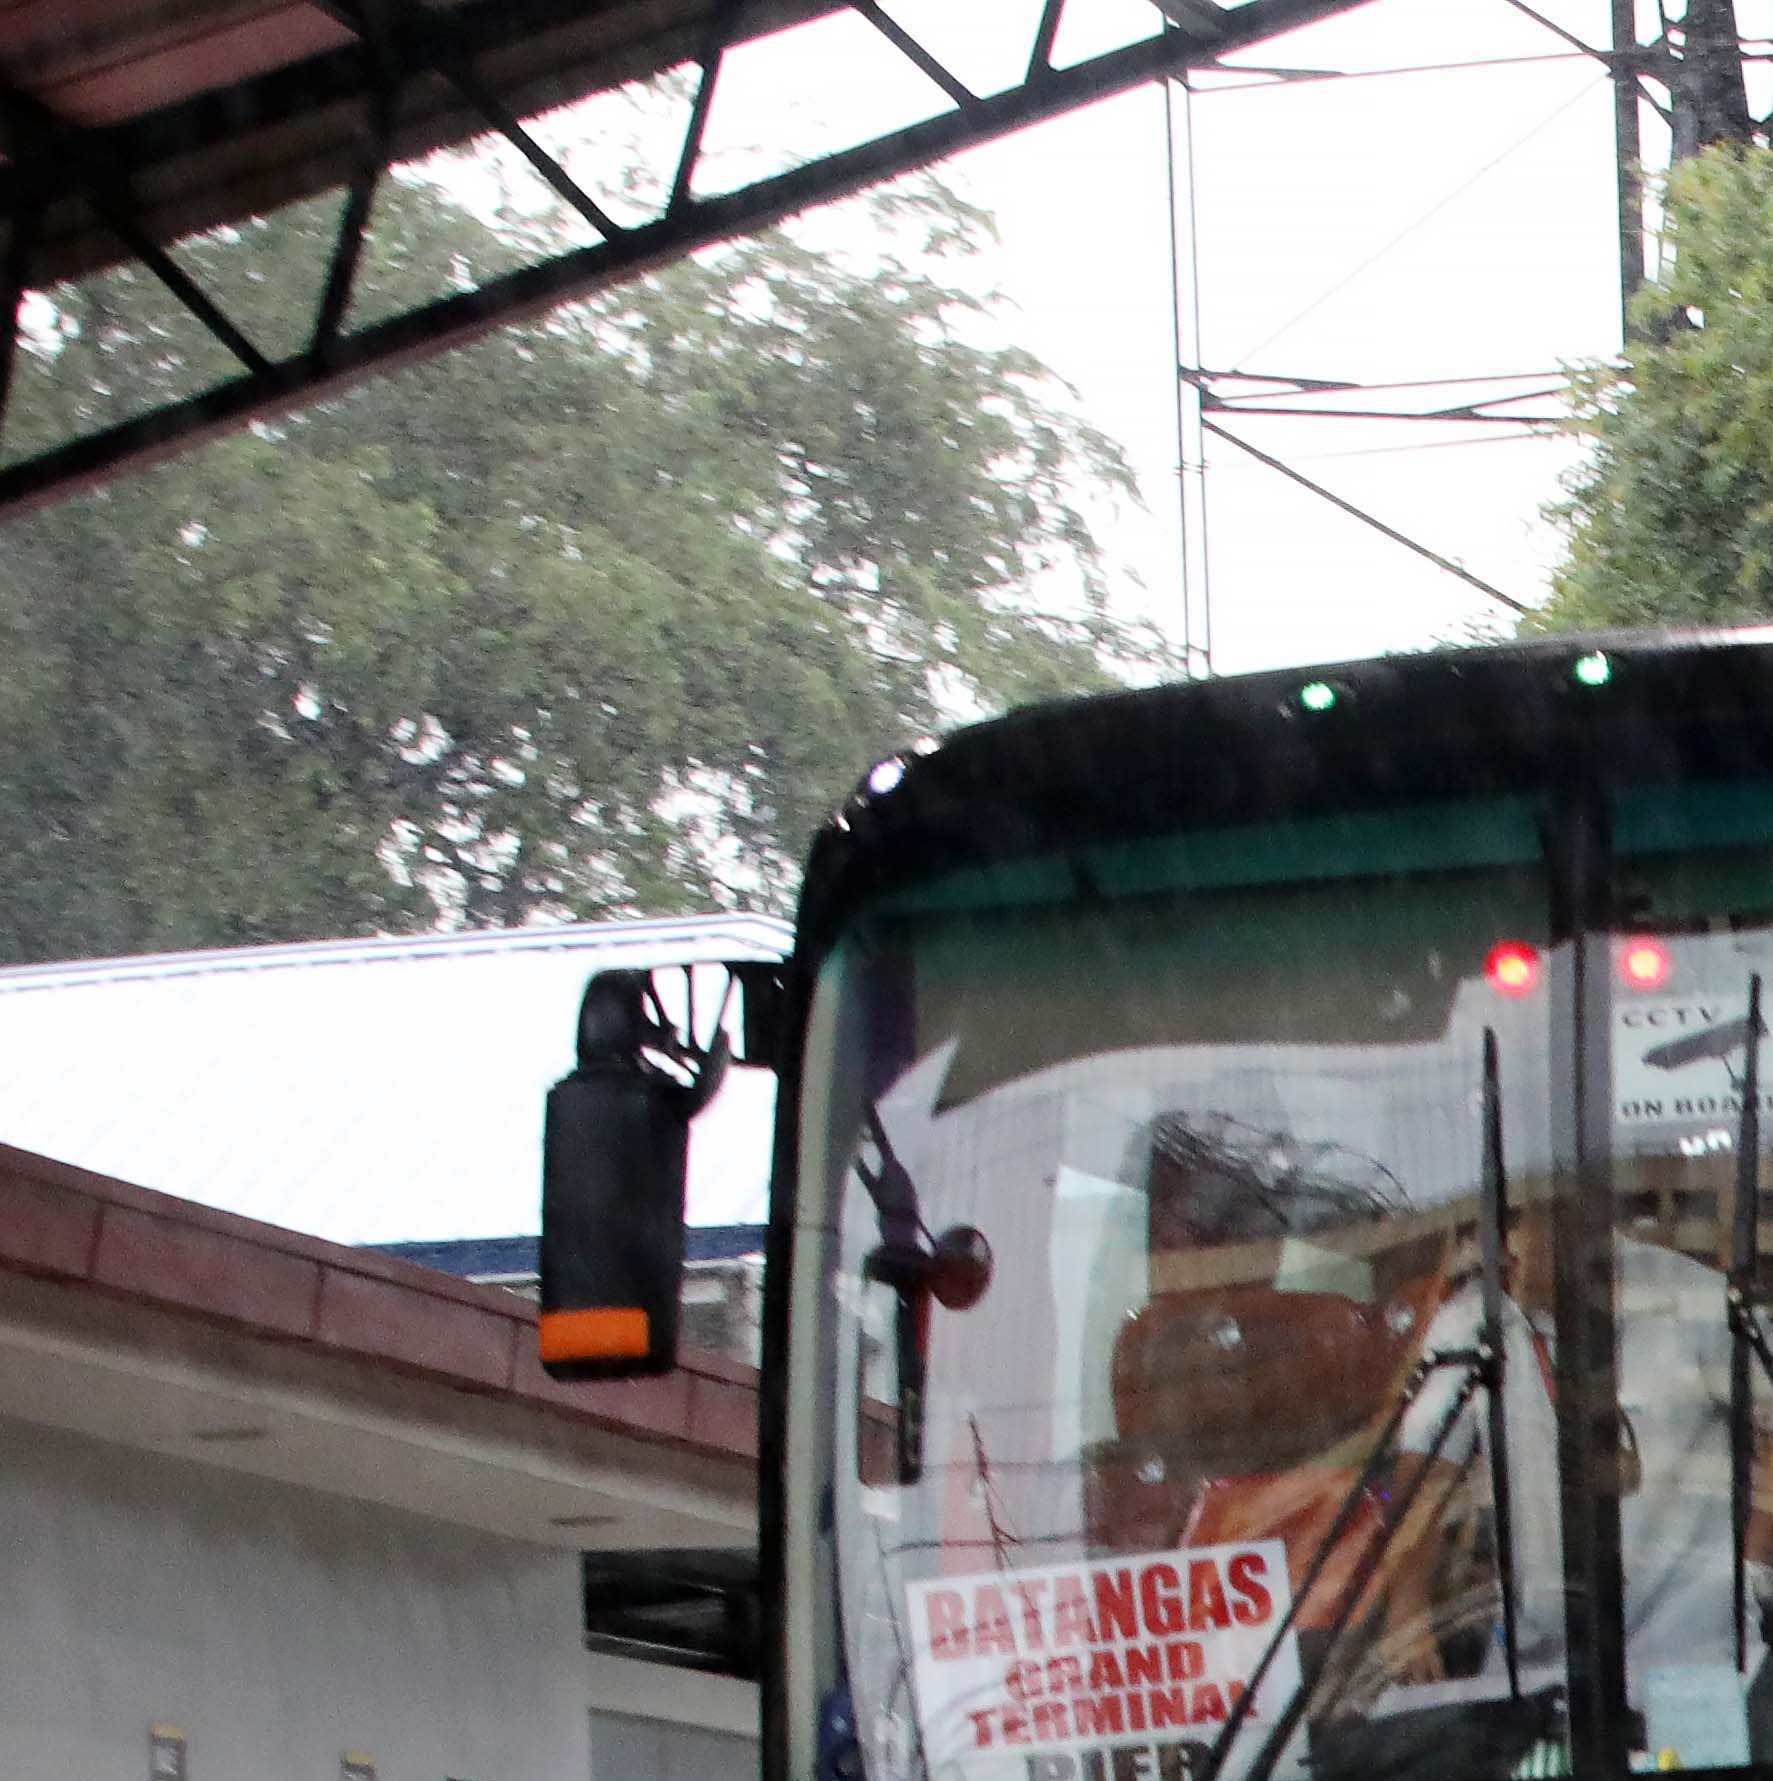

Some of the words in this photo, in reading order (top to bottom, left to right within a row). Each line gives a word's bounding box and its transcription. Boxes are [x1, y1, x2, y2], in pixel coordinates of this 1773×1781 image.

[1621, 1097, 1663, 1120] ON
[925, 1551, 1273, 1662] BATANGAS
[1005, 1640, 1206, 1700] GRAND
[968, 1680, 1258, 1750] TERMINAL
